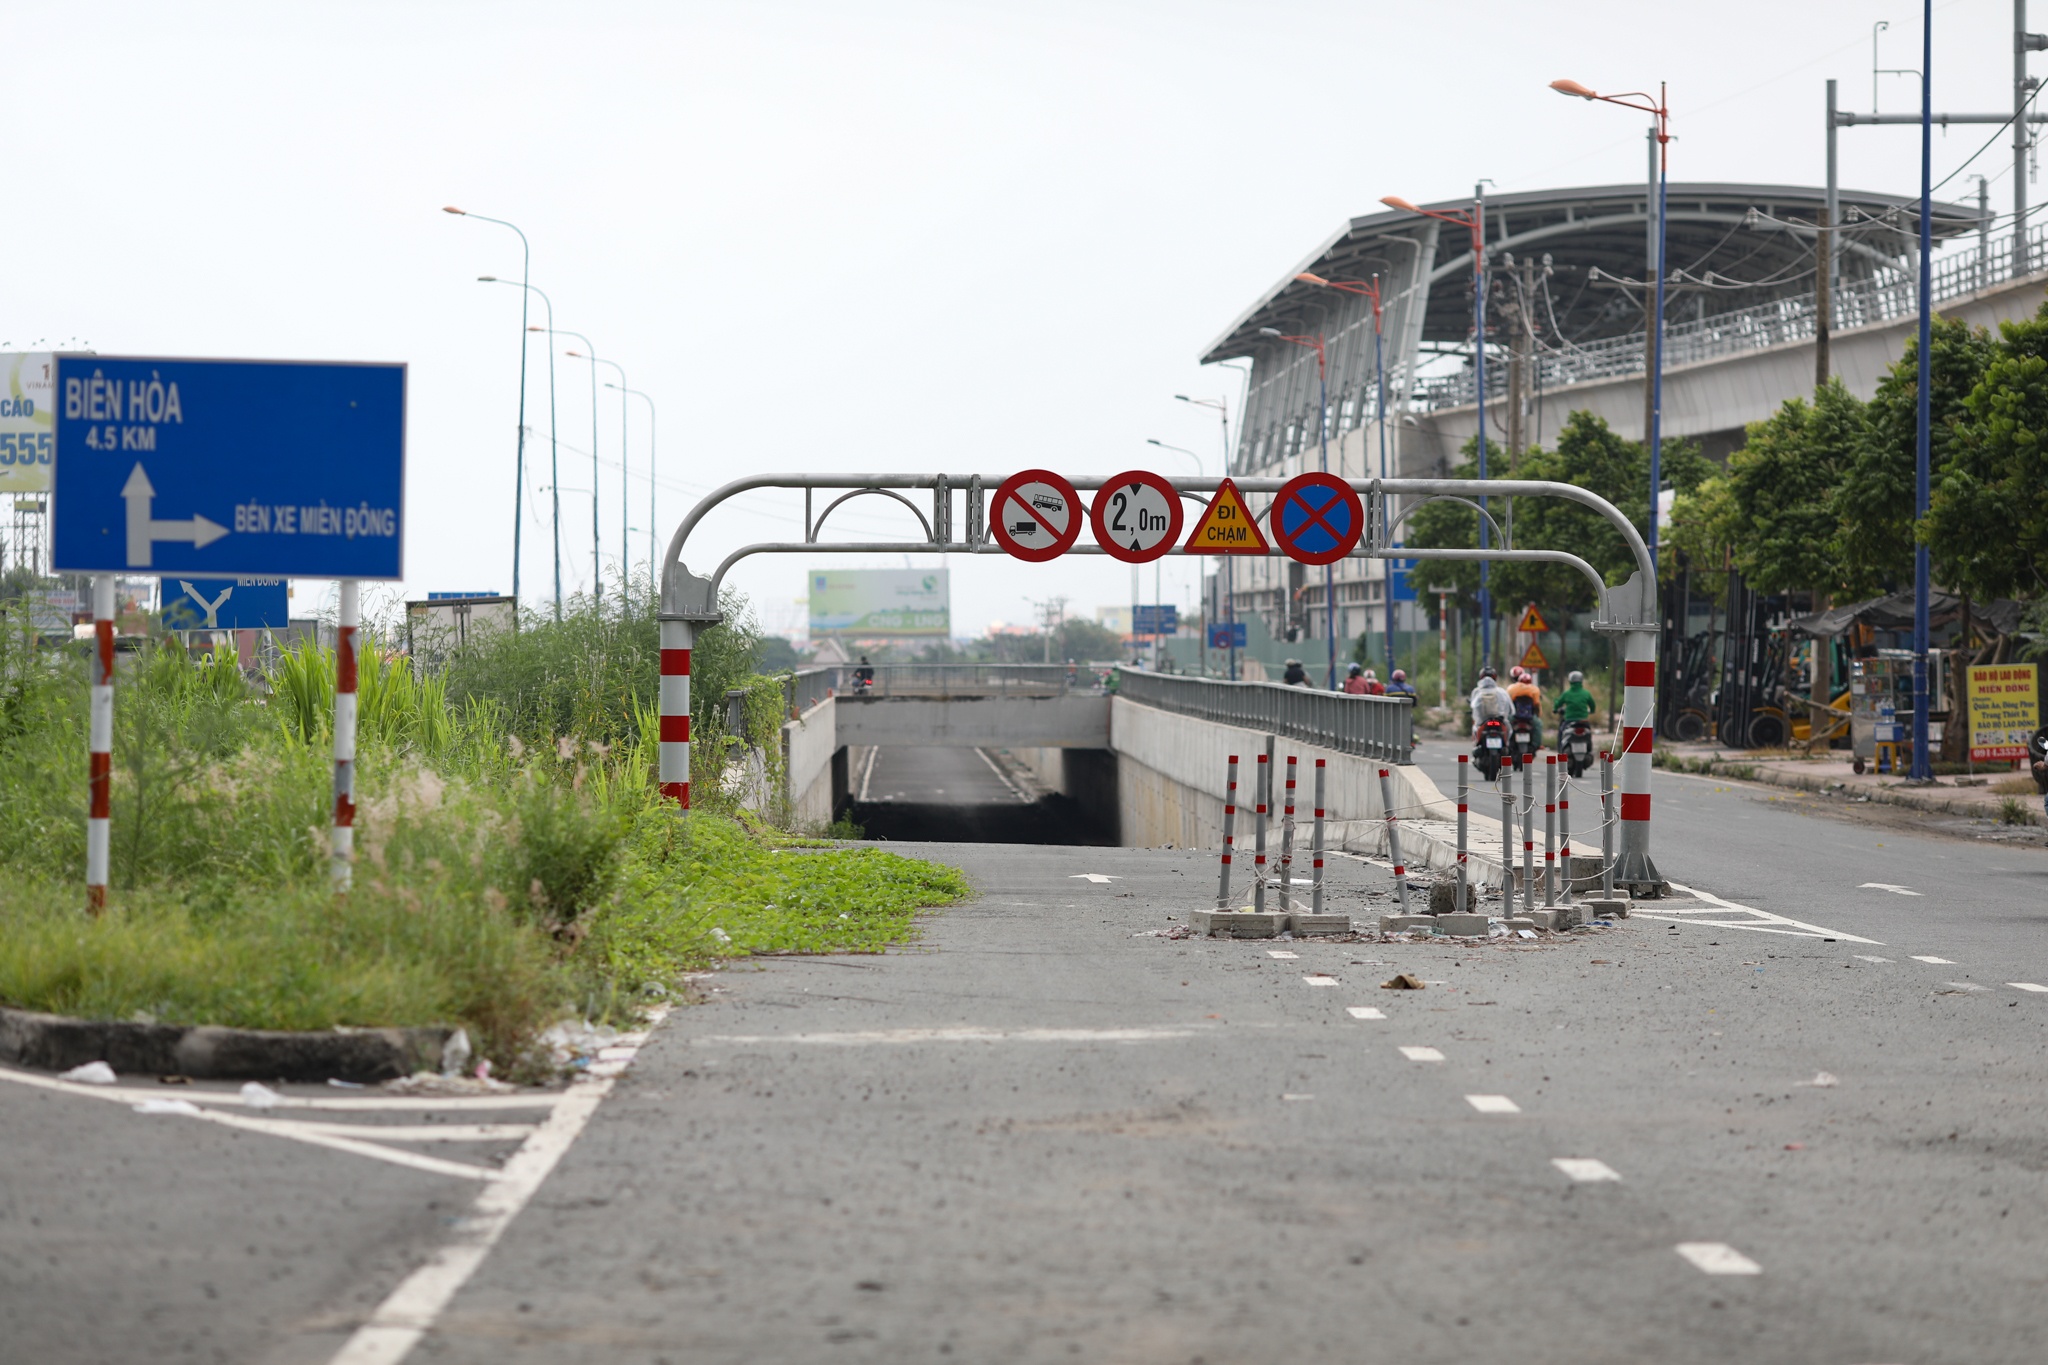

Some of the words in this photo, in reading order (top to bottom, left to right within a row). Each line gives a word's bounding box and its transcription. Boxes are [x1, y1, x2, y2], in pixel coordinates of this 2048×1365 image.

[0, 395, 34, 418] CÁO
[65, 369, 122, 421] BIÊN
[129, 370, 183, 424] HÒA
[85, 425, 117, 450] 4.5
[122, 426, 156, 451] KM
[273, 505, 296, 534] XE
[346, 501, 394, 537] ĐÔNG
[1112, 493, 1166, 536] 2,0m
[1217, 505, 1236, 519] ĐI
[1207, 525, 1247, 544] CHẬM
